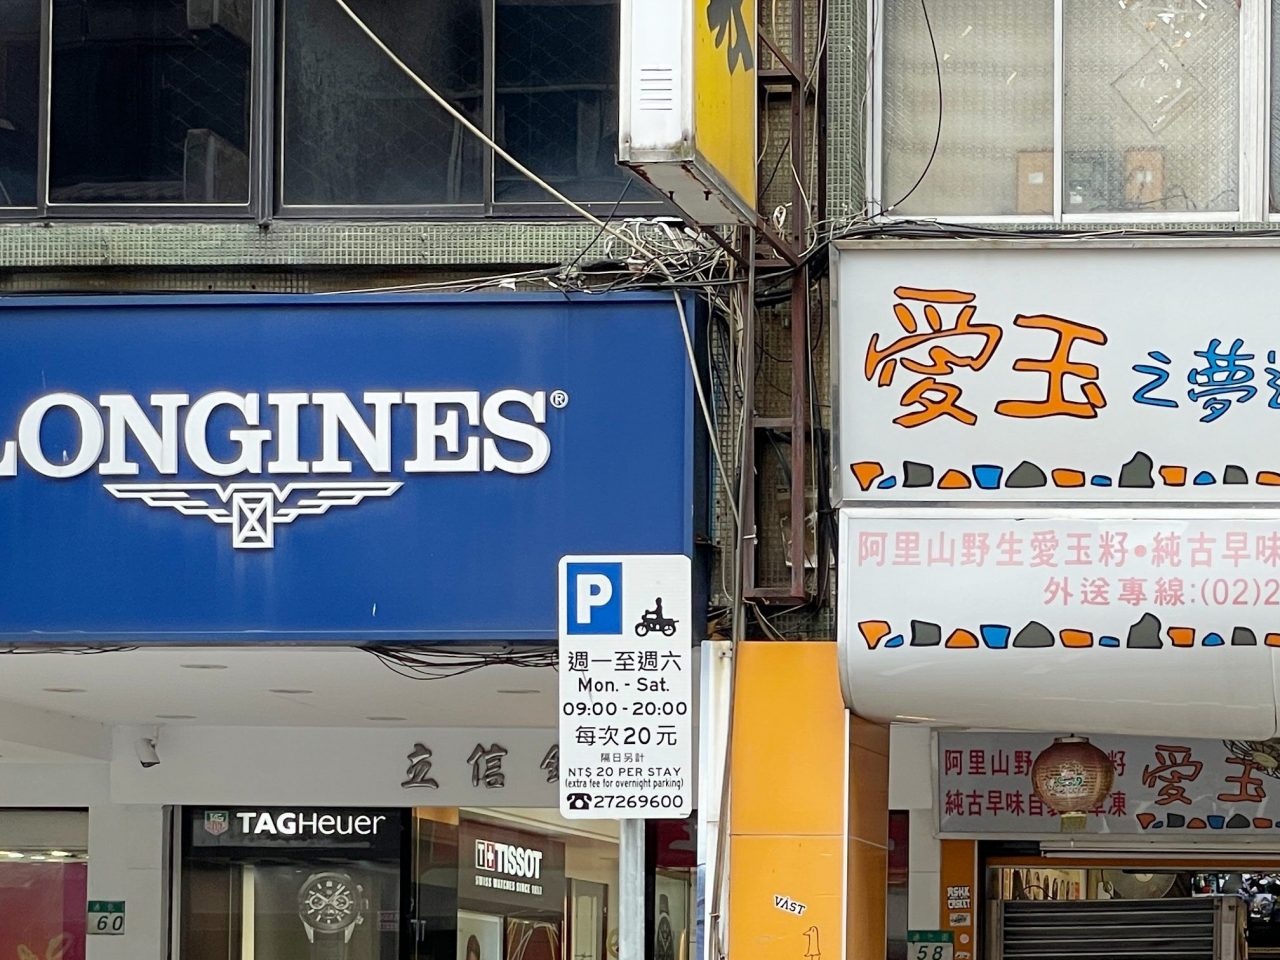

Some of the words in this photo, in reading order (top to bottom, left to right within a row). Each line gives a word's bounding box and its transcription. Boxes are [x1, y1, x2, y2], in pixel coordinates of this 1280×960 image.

[0, 390, 551, 478] ONGINES
[577, 574, 613, 624] P
[568, 651, 682, 672] 週一至週六
[578, 677, 618, 692] Mon.
[637, 677, 670, 692] Sat.
[563, 702, 617, 716] 09:00
[632, 702, 687, 716] 20:00
[600, 752, 645, 763] 隔日另計
[568, 767, 592, 778] NT$
[596, 767, 613, 777] 20
[618, 767, 641, 777] PER
[647, 767, 681, 777] STAY
[565, 778, 587, 789] (extra
[589, 778, 599, 787] fee
[602, 778, 613, 787] for
[615, 778, 650, 790] overnight
[653, 778, 684, 790] parking)
[594, 795, 683, 809] 27269600
[97, 915, 123, 931] 60
[917, 945, 943, 960] 58
